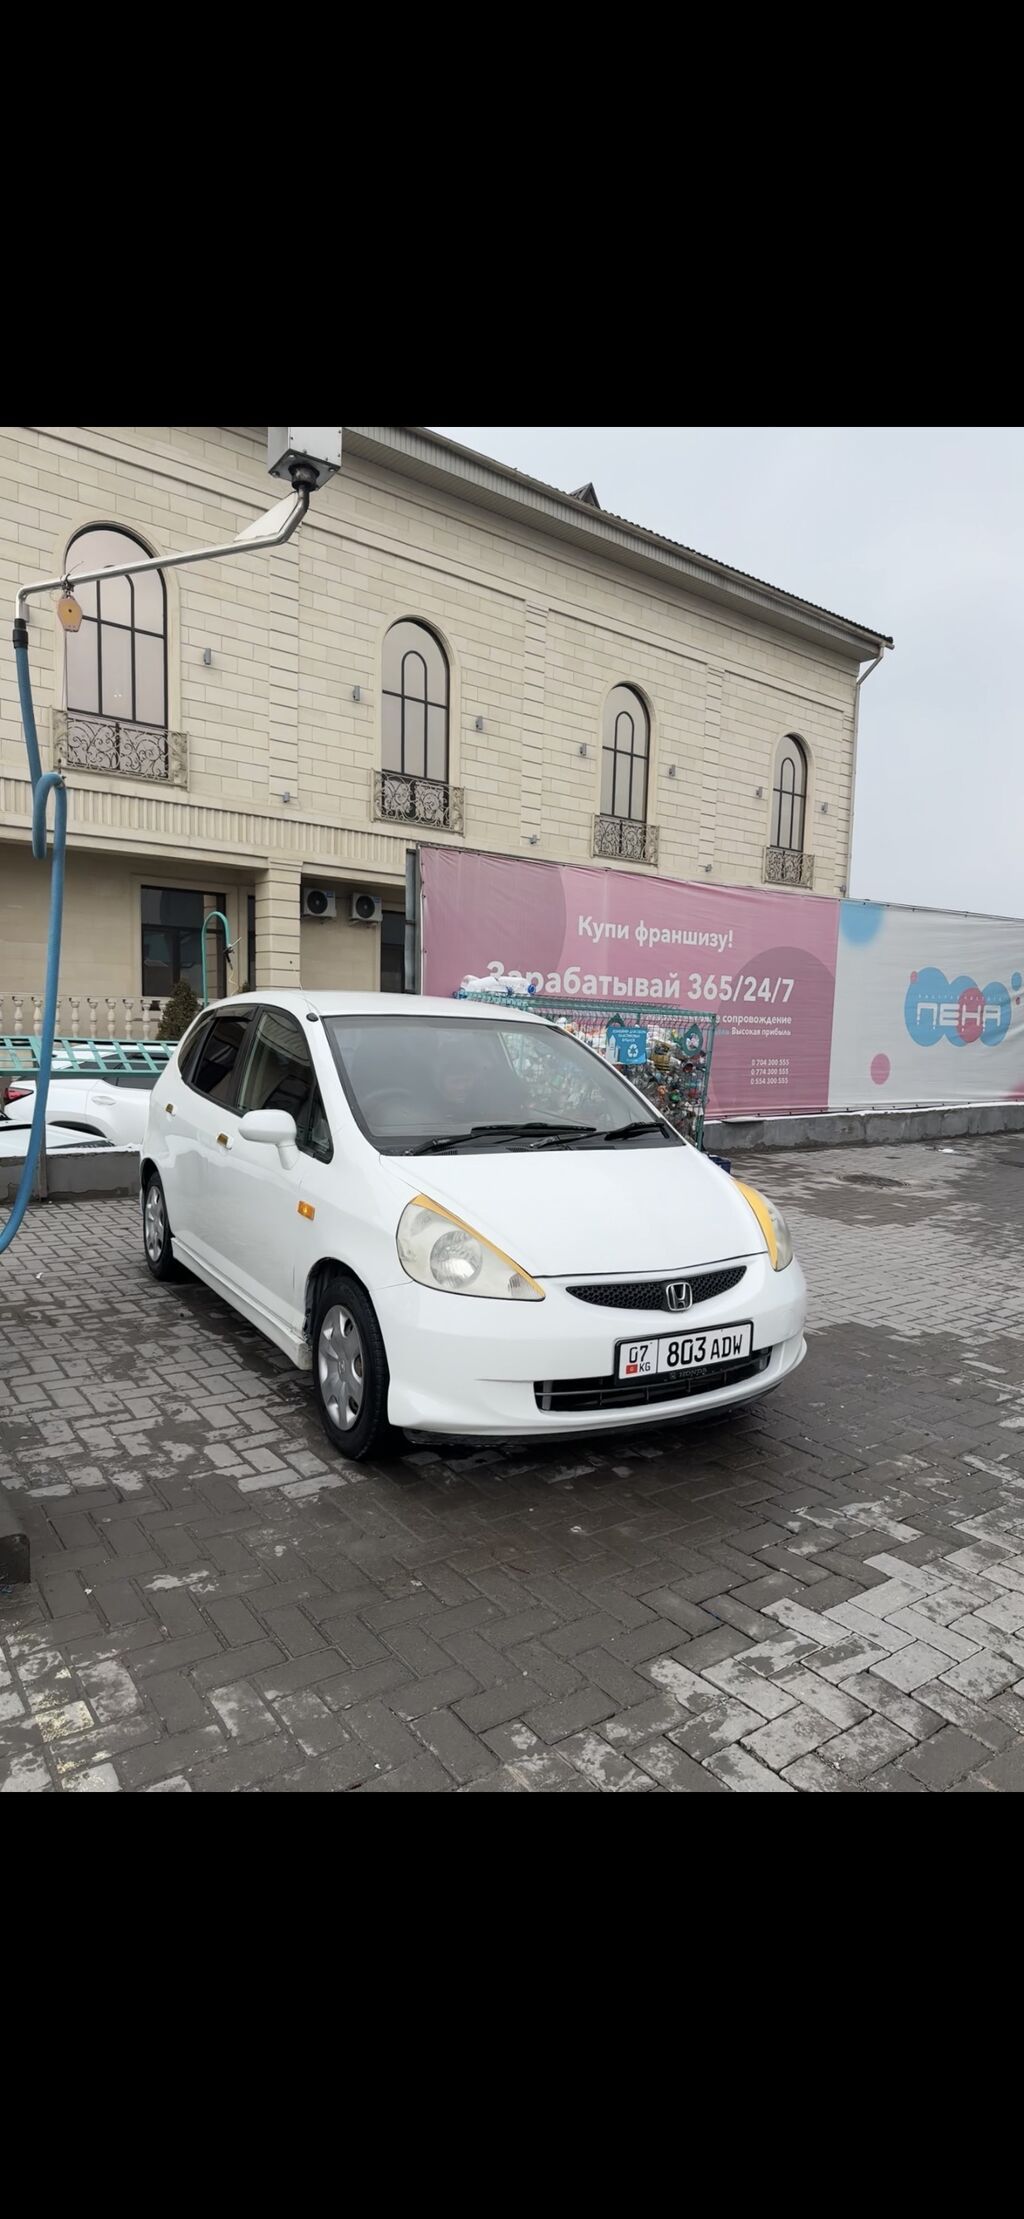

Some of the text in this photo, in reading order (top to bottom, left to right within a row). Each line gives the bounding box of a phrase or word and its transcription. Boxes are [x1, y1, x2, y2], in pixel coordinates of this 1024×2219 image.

[577, 915, 734, 952] Купи франшизу!
[687, 973, 795, 1003] 365/24/7
[722, 1015, 792, 1025] сопровождение
[916, 1002, 1001, 1030] ПЕНА
[731, 1027, 760, 1036] Высокая
[761, 1027, 791, 1038] прибыль
[629, 1345, 648, 1363] 07
[667, 1334, 743, 1367] 803 ADW
[639, 1362, 651, 1373] KG
